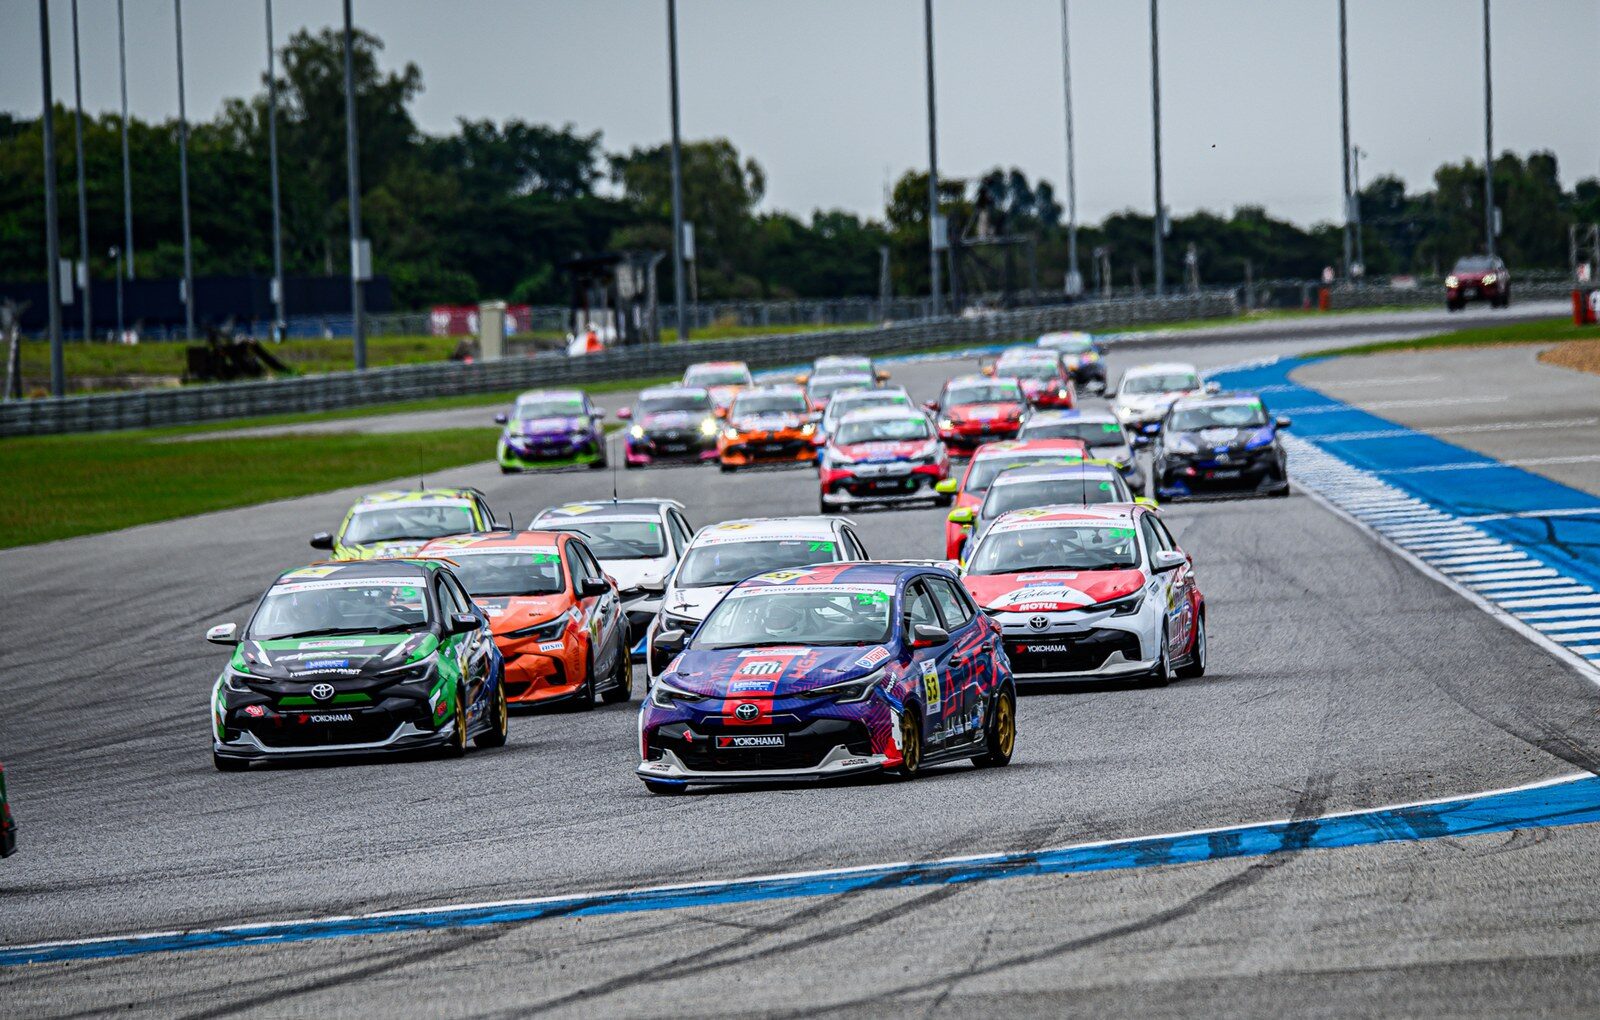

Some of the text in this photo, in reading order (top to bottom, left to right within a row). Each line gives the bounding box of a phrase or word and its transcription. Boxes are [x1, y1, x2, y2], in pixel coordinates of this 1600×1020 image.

[807, 541, 834, 552] 73
[401, 585, 417, 598] 5
[1019, 602, 1059, 612] MOTUL
[1027, 644, 1067, 653] YOKOHAMA
[862, 647, 889, 664] Trane
[925, 676, 939, 702] 53
[310, 713, 354, 723] YOKOHAMA
[733, 736, 783, 747] YOKOHAMA
